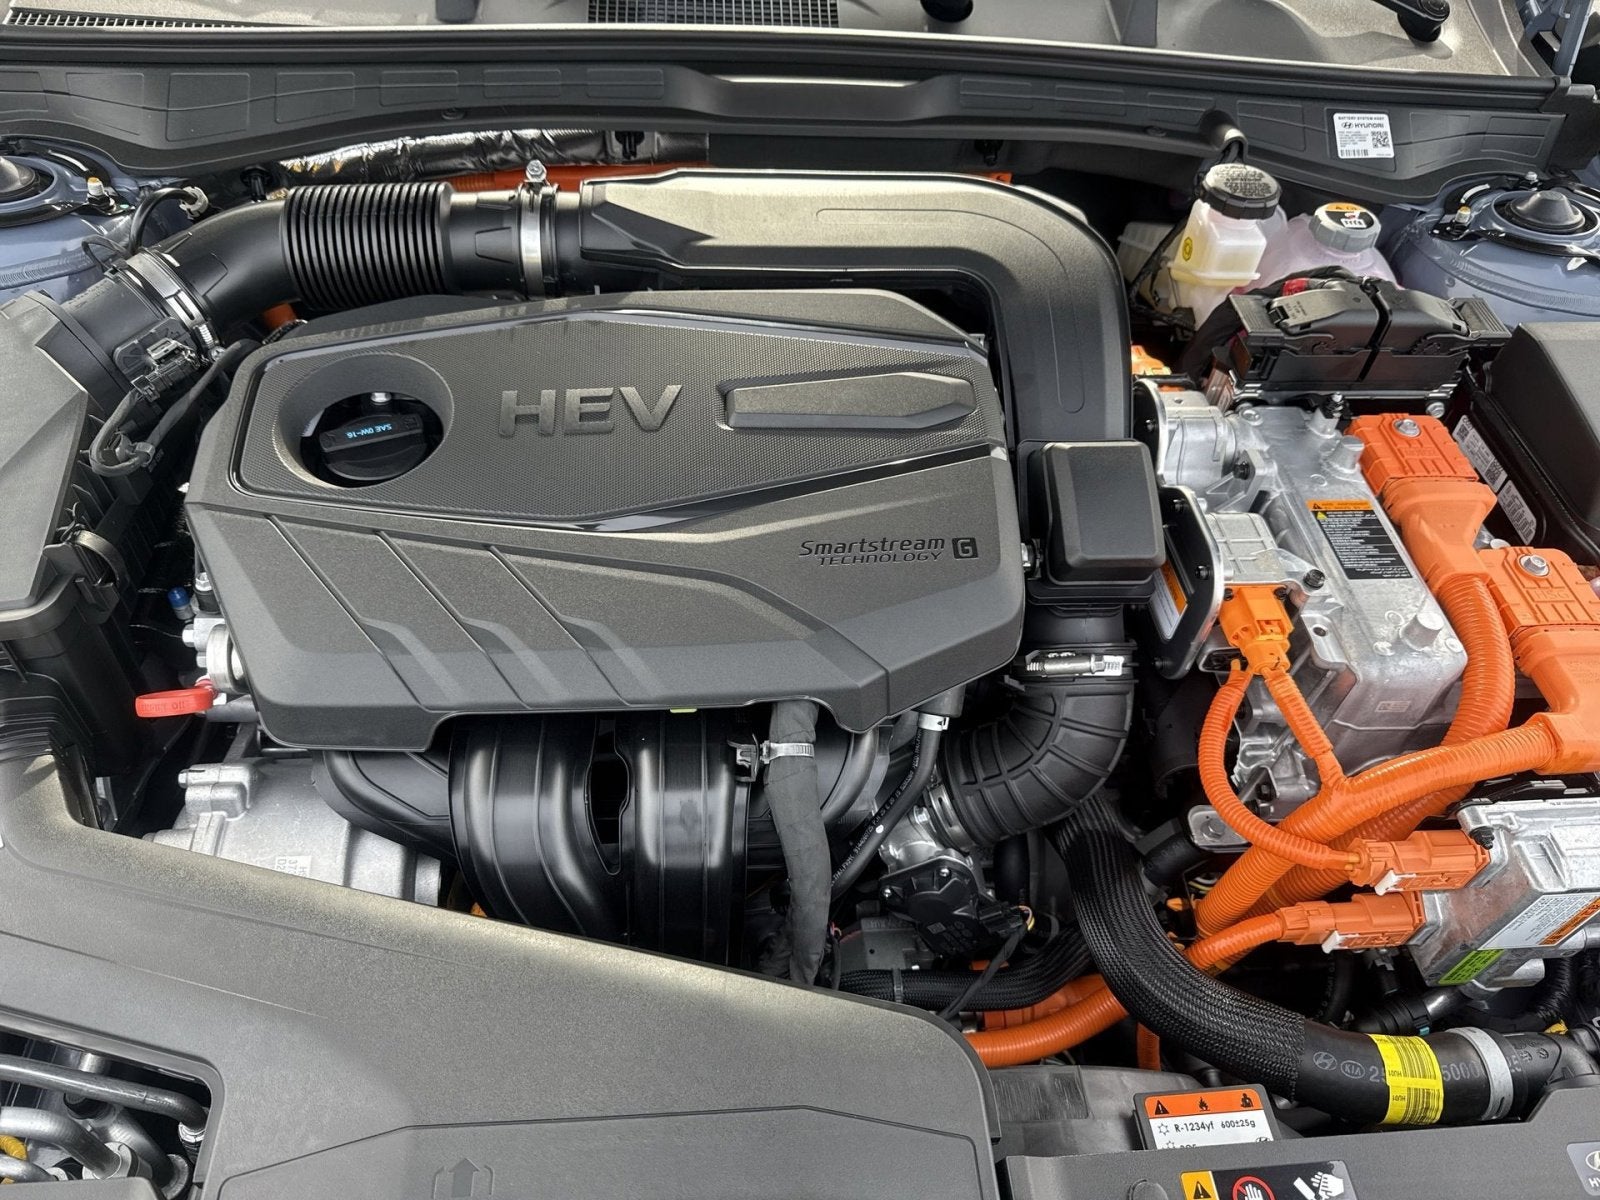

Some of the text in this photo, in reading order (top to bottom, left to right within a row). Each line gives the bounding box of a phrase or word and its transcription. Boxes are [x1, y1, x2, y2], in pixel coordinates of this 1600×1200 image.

[500, 384, 682, 437] HEV
[375, 423, 392, 433] SAE
[799, 537, 976, 558] Smartstream G
[819, 552, 942, 566] TECHNOLOGY
[1343, 1062, 1363, 1077] KIA
[1174, 1119, 1256, 1133] R-1234yf 600±25g
